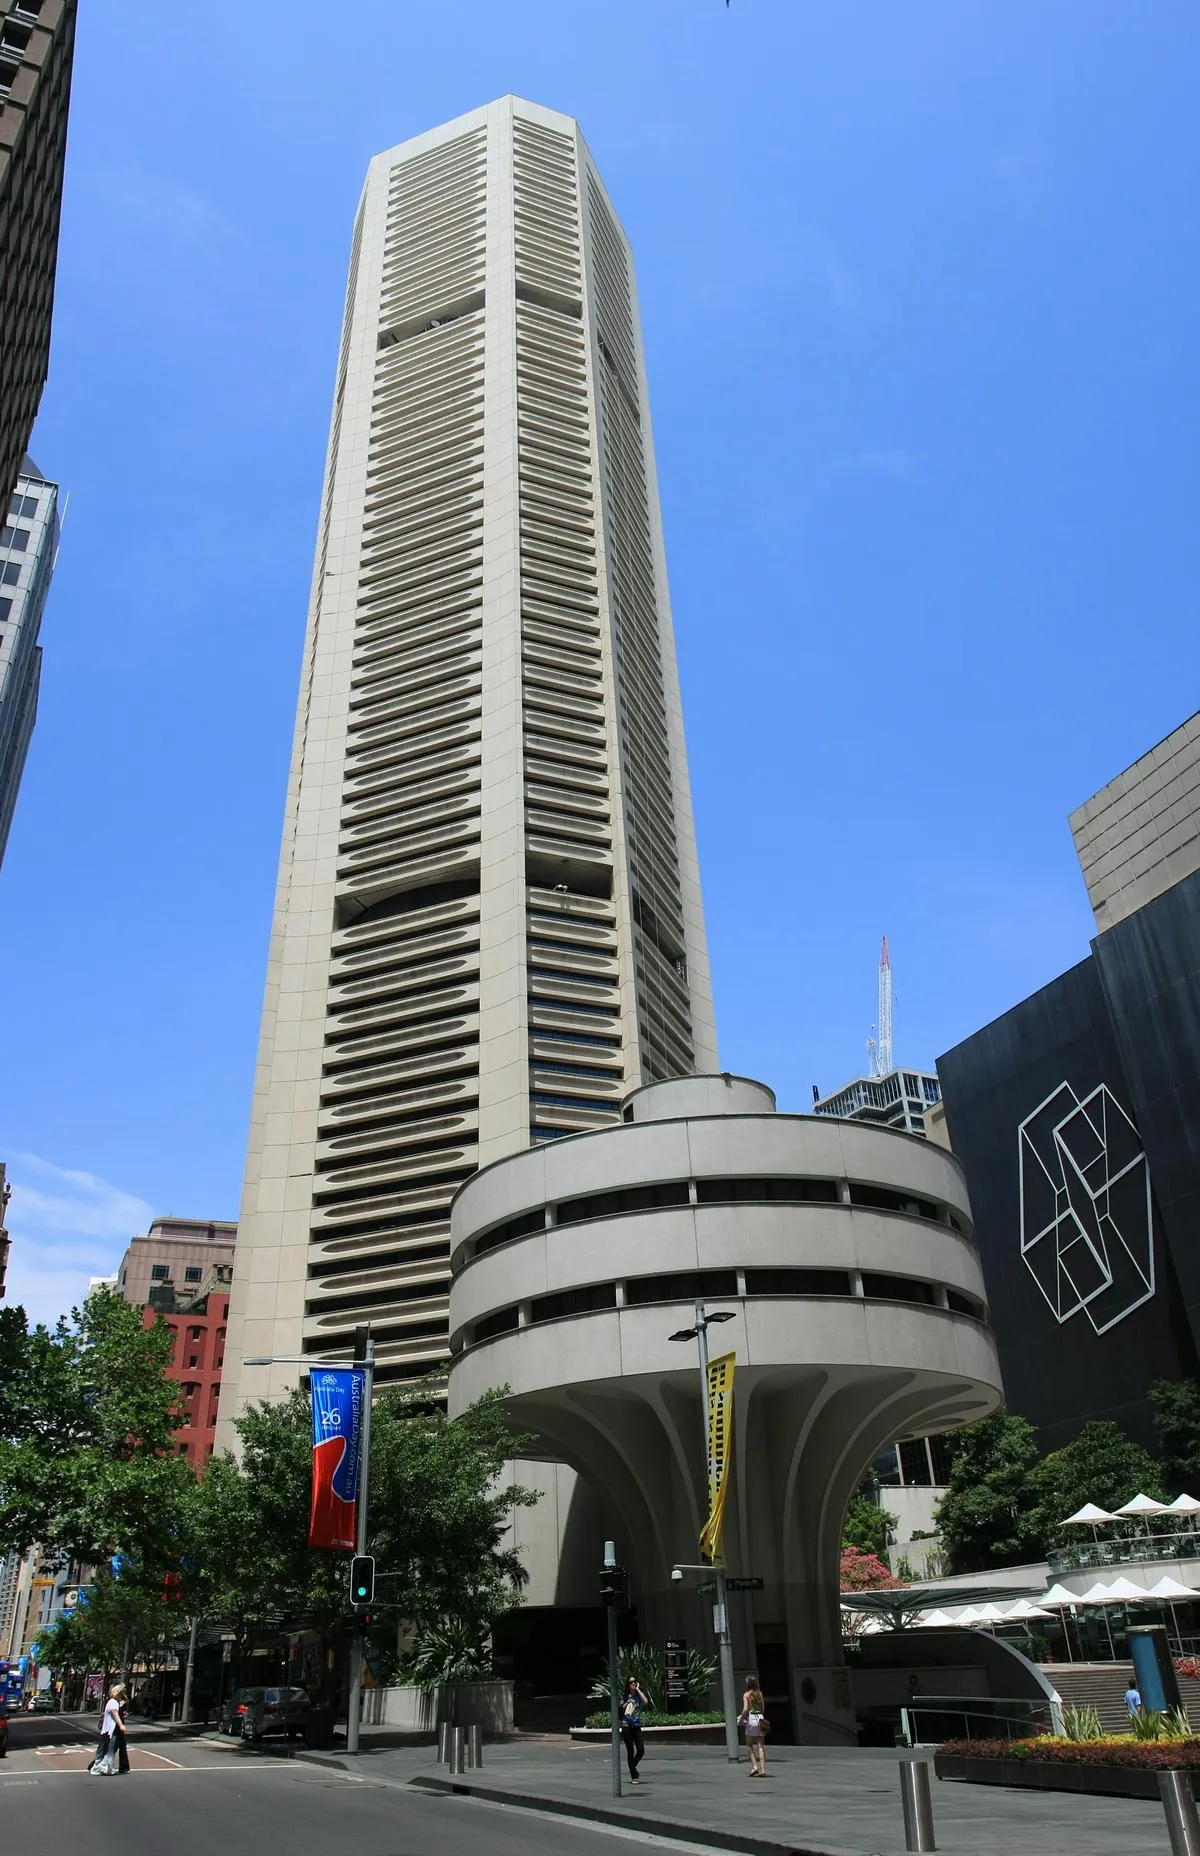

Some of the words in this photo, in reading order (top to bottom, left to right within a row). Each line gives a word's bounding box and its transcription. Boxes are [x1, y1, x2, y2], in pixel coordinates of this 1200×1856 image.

[335, 1386, 346, 1394] Day
[321, 1408, 341, 1425] 26
[346, 1374, 361, 1494] AustraliaDay.com.au
